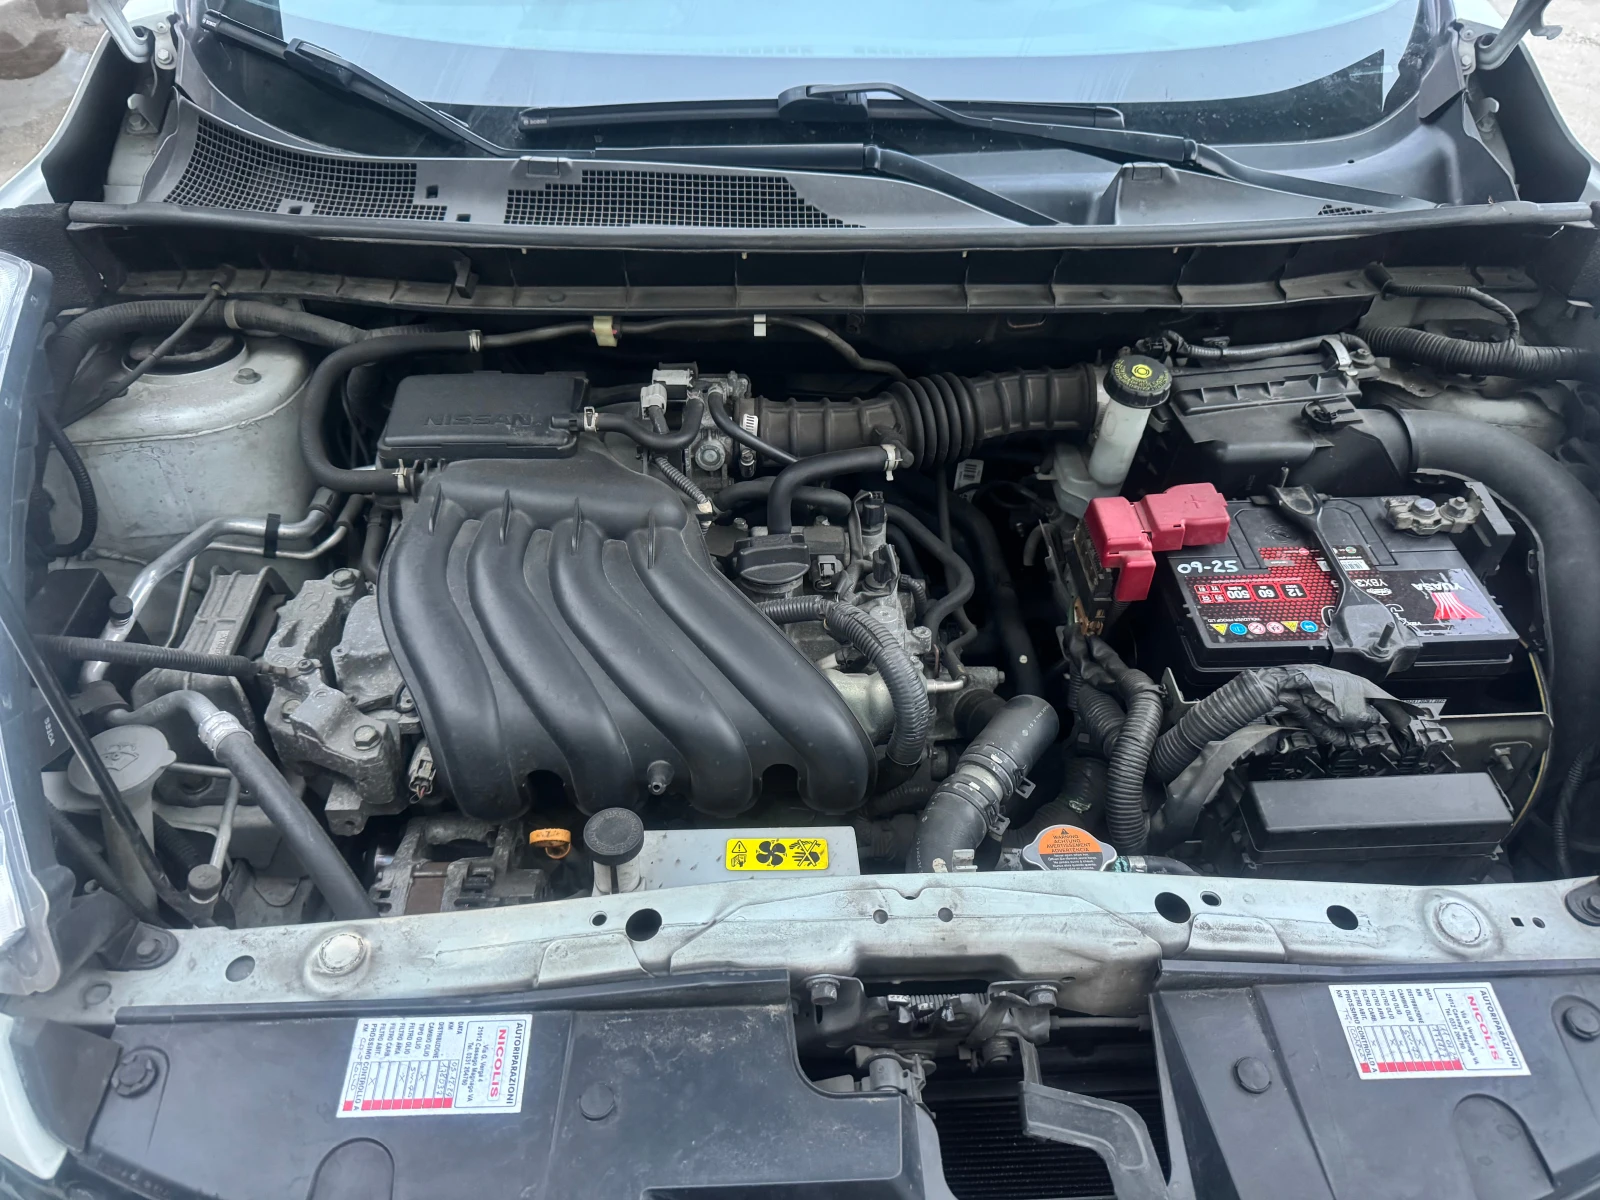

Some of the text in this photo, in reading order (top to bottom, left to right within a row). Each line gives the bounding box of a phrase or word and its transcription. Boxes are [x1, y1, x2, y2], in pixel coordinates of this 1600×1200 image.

[423, 413, 533, 426] NISSAN
[1177, 560, 1239, 574] 09-25
[1227, 589, 1251, 599] 500
[1258, 589, 1275, 598] 60
[1287, 588, 1304, 597] 12
[1411, 582, 1466, 591] YUASA
[1360, 989, 1371, 1006] FILTRO
[1388, 990, 1402, 1014] TIPO OLIO
[1414, 988, 1422, 996] KM
[1424, 988, 1433, 1000] DATA
[1351, 989, 1367, 1020] FILTRO ABIT.
[1369, 989, 1385, 1019] FILTRO ARIA
[1378, 989, 1394, 1018] FILTRO OLIO
[1396, 988, 1414, 1021] CAMBIO OLIO
[1405, 988, 1424, 1023] DISTRIBUZIONE
[362, 1023, 368, 1031] KM
[387, 1023, 395, 1040] FILTRO
[396, 1022, 405, 1040] FILTRO
[406, 1022, 415, 1040] FILTRO
[425, 1022, 434, 1042] CAMBIO
[447, 1021, 454, 1029] KM
[1343, 989, 1360, 1024] PROSSIMO
[1356, 1026, 1375, 1065] CONTROLLO
[1448, 1018, 1458, 1029] 0331
[1459, 1010, 1467, 1018] Via
[1465, 1026, 1477, 1041] Verga
[1466, 996, 1500, 1059] NICOLIS
[1479, 990, 1518, 1066] AUTORIPARAZIONI
[364, 1023, 377, 1059] PROSSIMO
[374, 1023, 386, 1055] FILTRO ABIT.
[414, 1036, 422, 1049] OLIO
[432, 1022, 444, 1058] DISTRIBUZIONE
[1460, 1032, 1476, 1055] Magnago
[476, 1061, 485, 1077] Verga
[490, 1029, 506, 1097] NICOLIS
[506, 1022, 522, 1103] AUTORIPARAZIONI
[354, 1061, 369, 1103] CONTROLLO
[467, 1067, 477, 1092] Magnago
